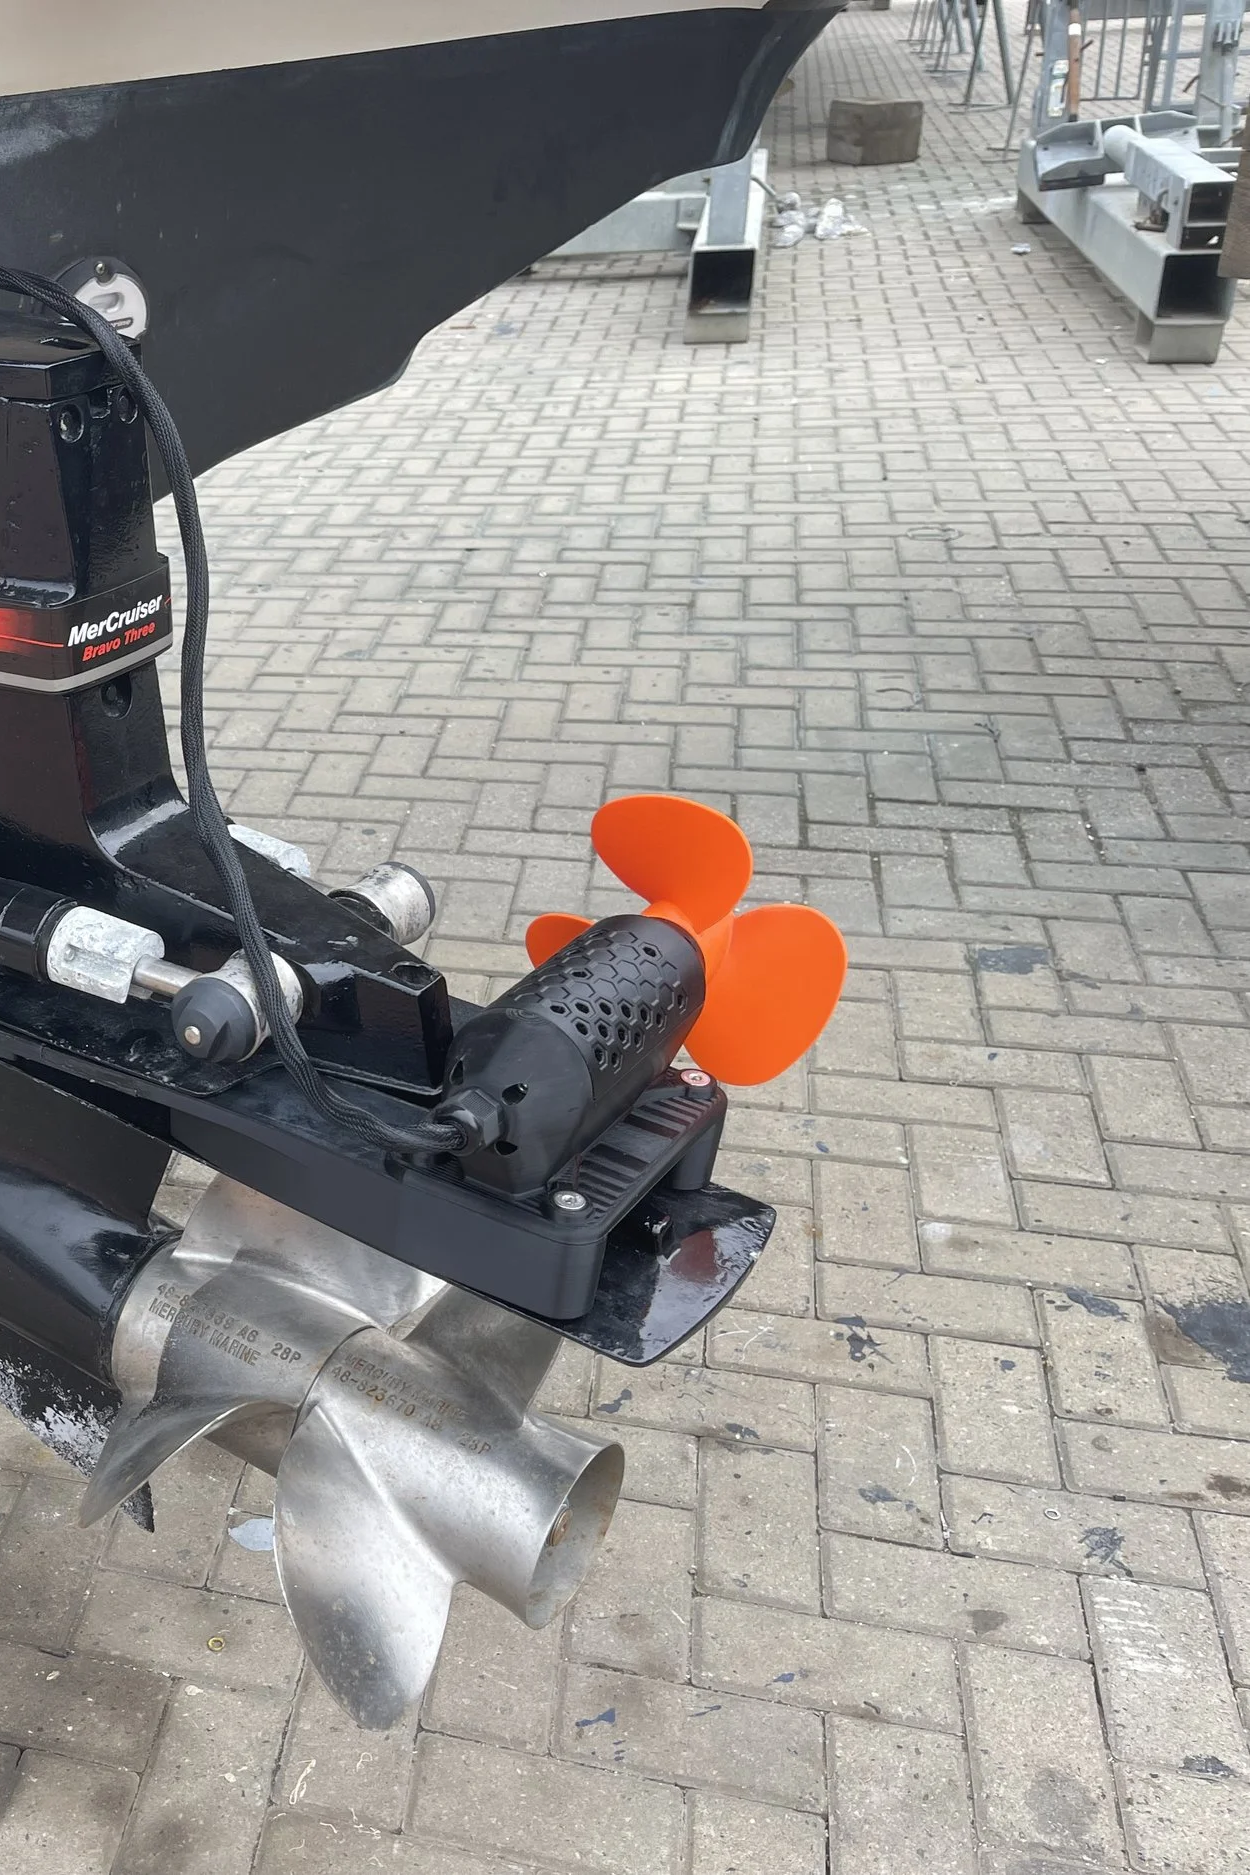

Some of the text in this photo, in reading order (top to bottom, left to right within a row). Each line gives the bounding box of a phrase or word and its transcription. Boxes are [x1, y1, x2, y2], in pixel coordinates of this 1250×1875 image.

[67, 594, 163, 647] MerCruiser
[82, 621, 156, 662] Bravo Three
[148, 1297, 261, 1367] MERCURY MARINE
[270, 1341, 302, 1364] 28P
